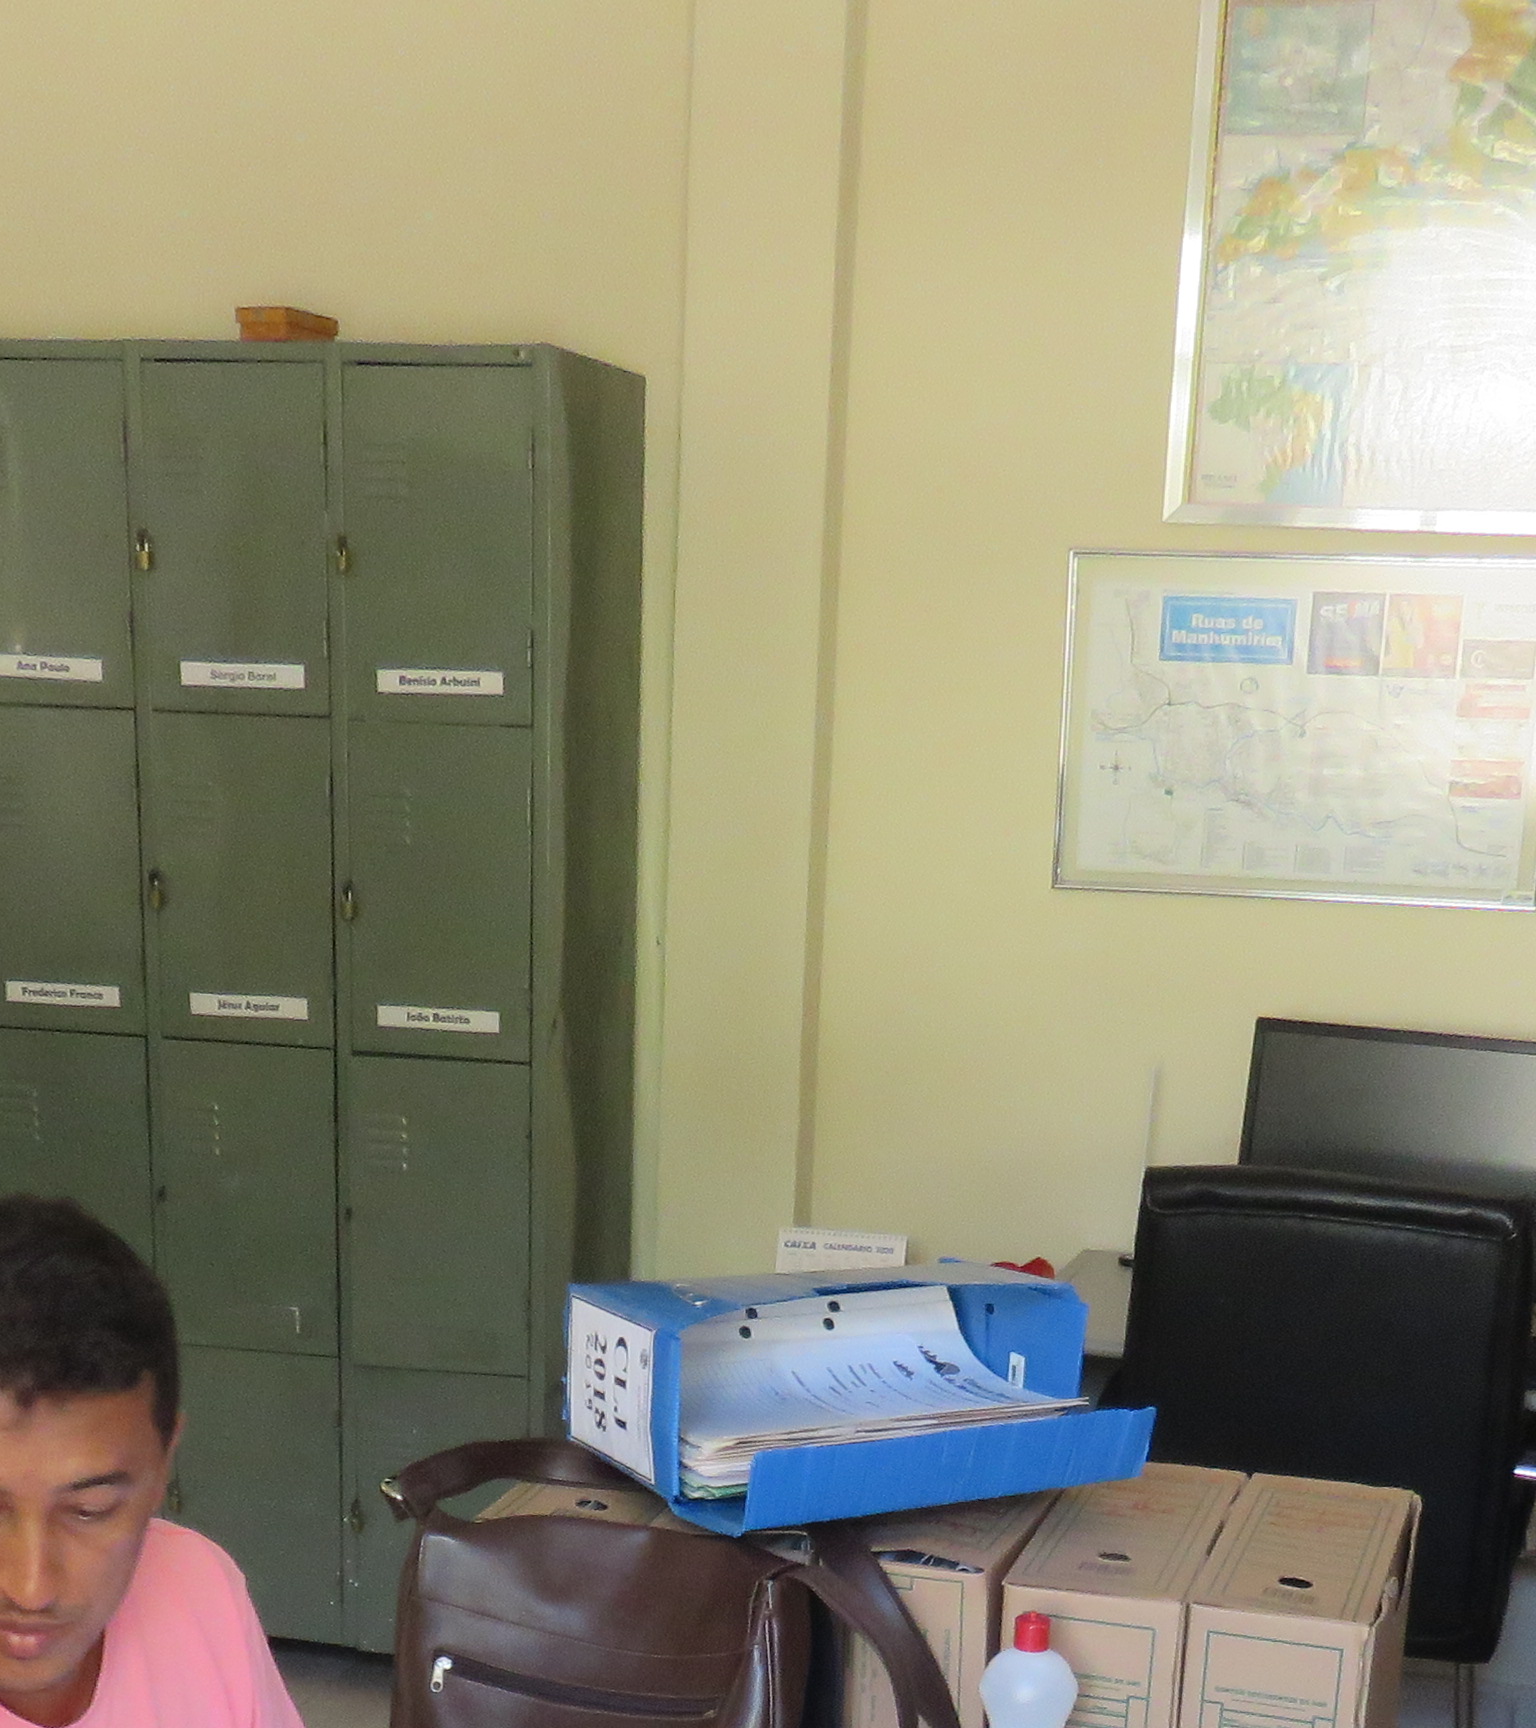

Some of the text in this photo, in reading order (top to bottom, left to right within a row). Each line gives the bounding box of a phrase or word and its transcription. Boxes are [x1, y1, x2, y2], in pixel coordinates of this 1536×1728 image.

[1191, 613, 1264, 630] Ruas de
[16, 660, 37, 672] Ana
[593, 1331, 608, 1432] 2018
